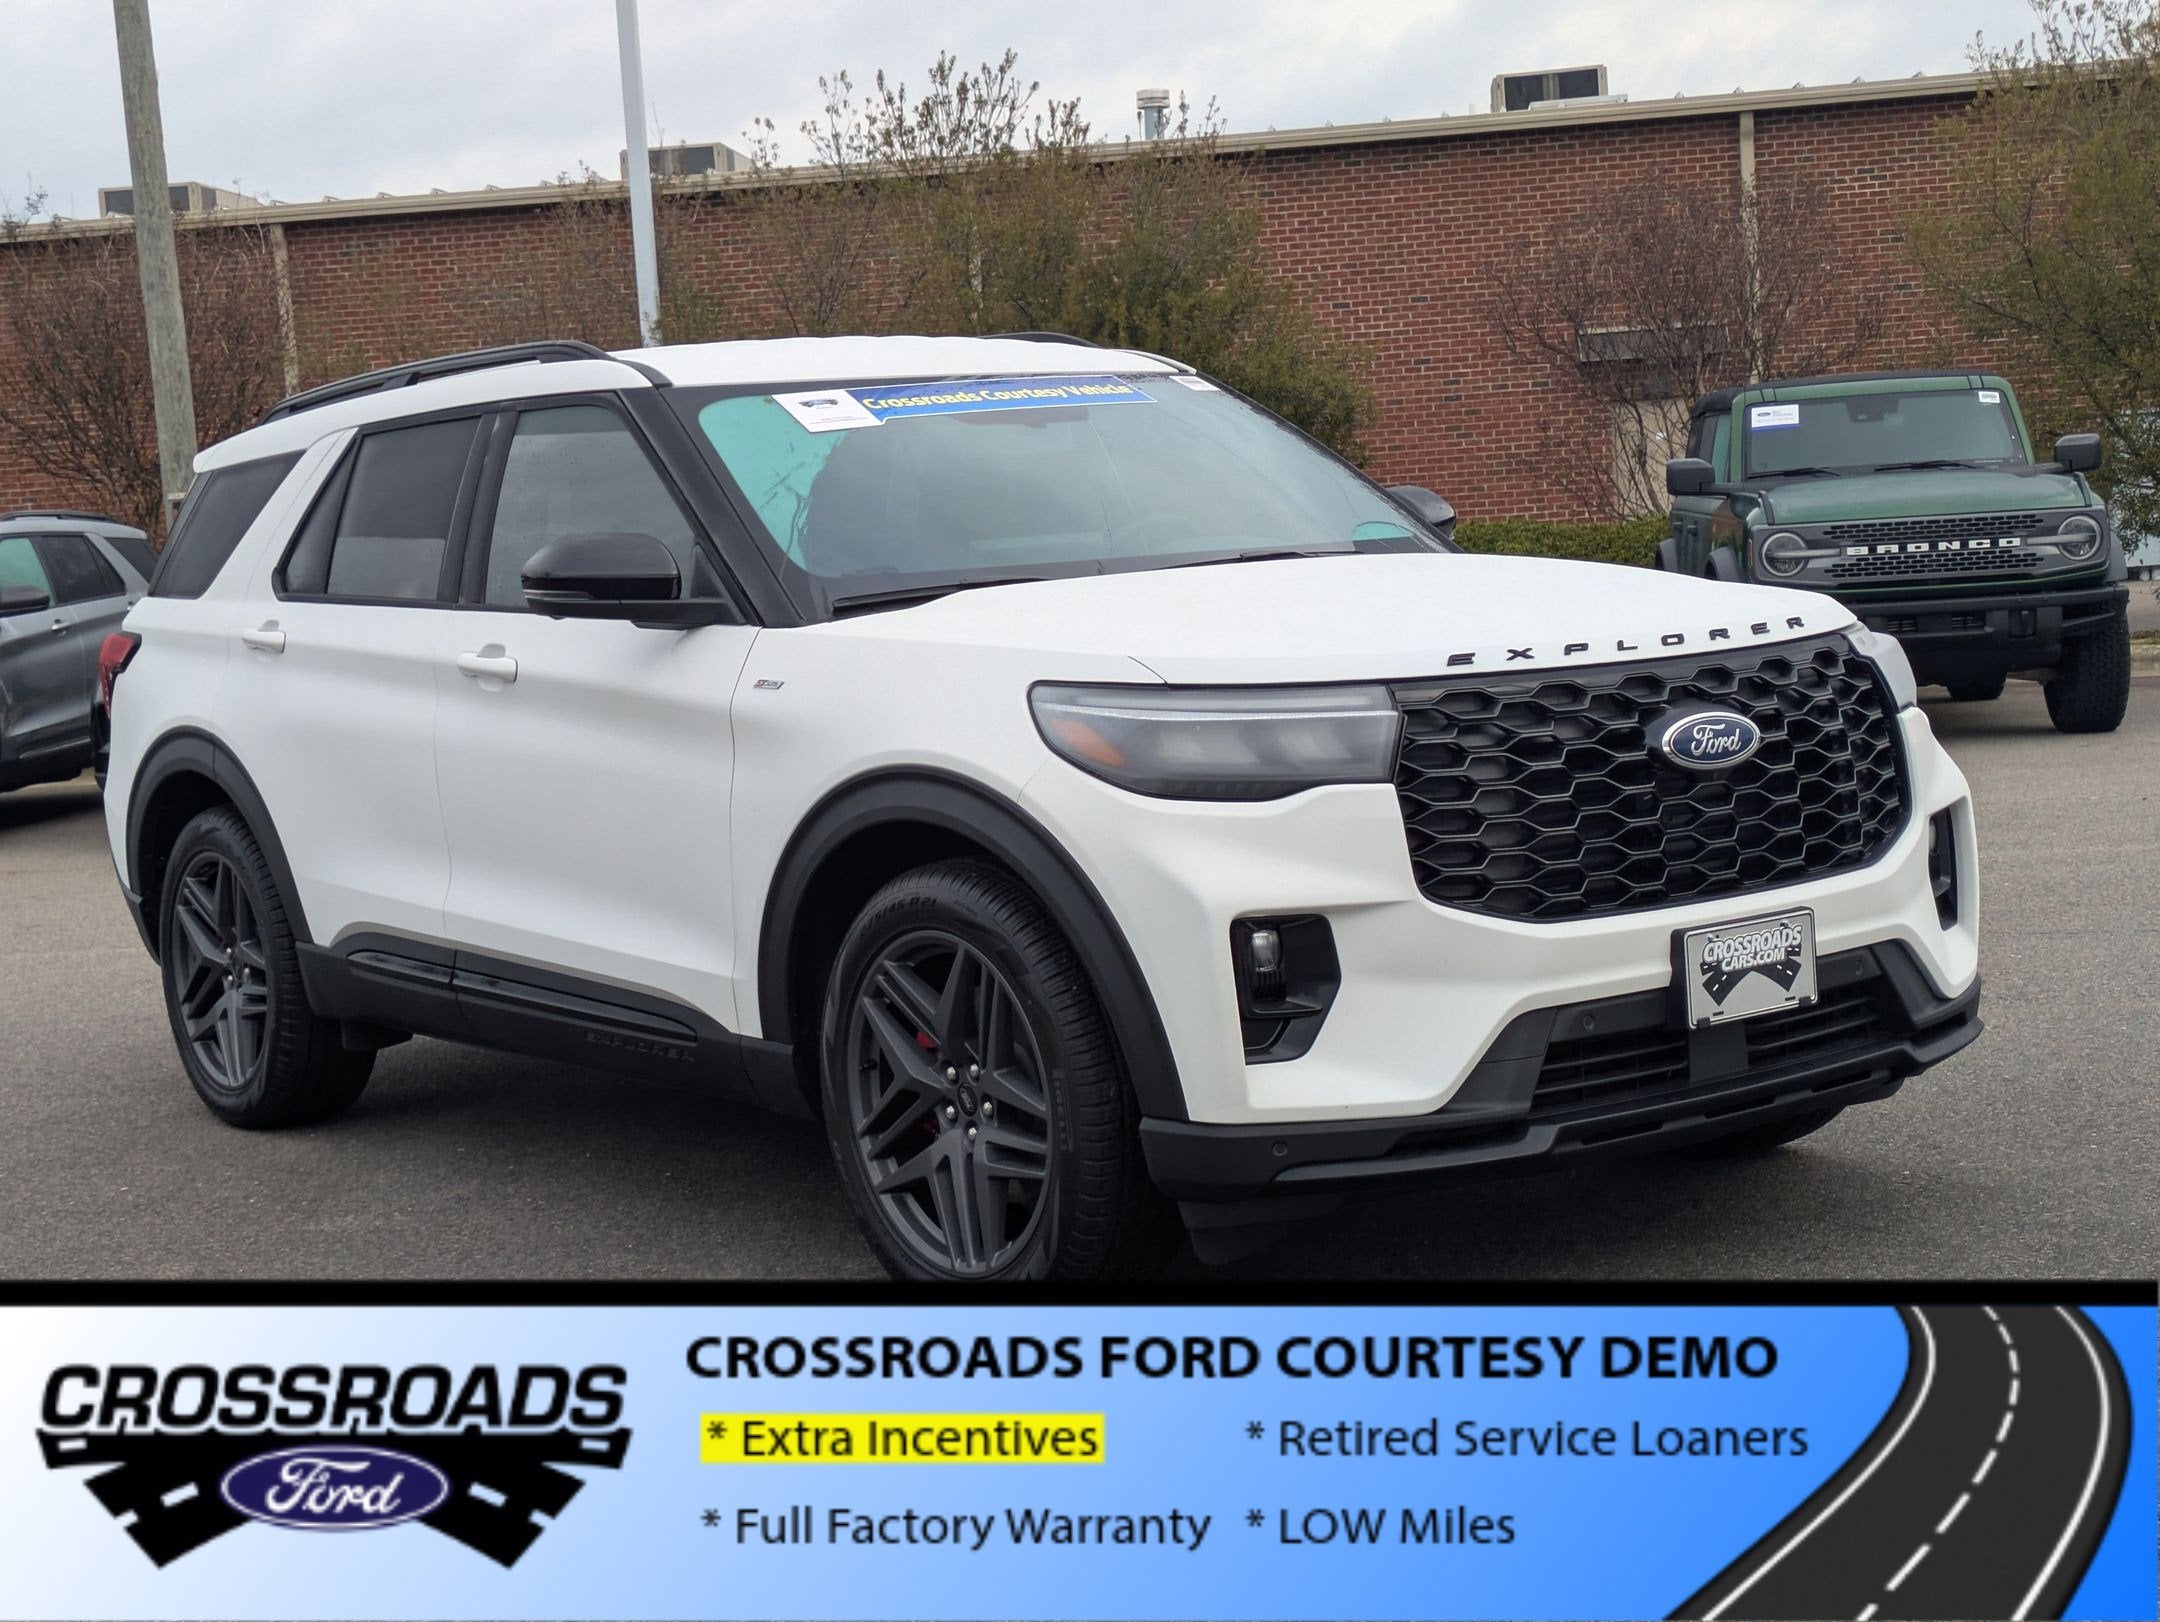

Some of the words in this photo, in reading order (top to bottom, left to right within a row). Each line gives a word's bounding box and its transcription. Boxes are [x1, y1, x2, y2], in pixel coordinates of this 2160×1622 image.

[863, 390, 981, 409] Crossroads
[982, 386, 1065, 402] Courtesy
[1066, 383, 1134, 397] Vehicle
[1846, 537, 2021, 556] BRONCO
[1446, 616, 1806, 667] EXPLORER
[1690, 723, 1742, 755] Ford
[1703, 925, 1803, 963] CROSSROADS
[1722, 947, 1786, 971] CARS.COM
